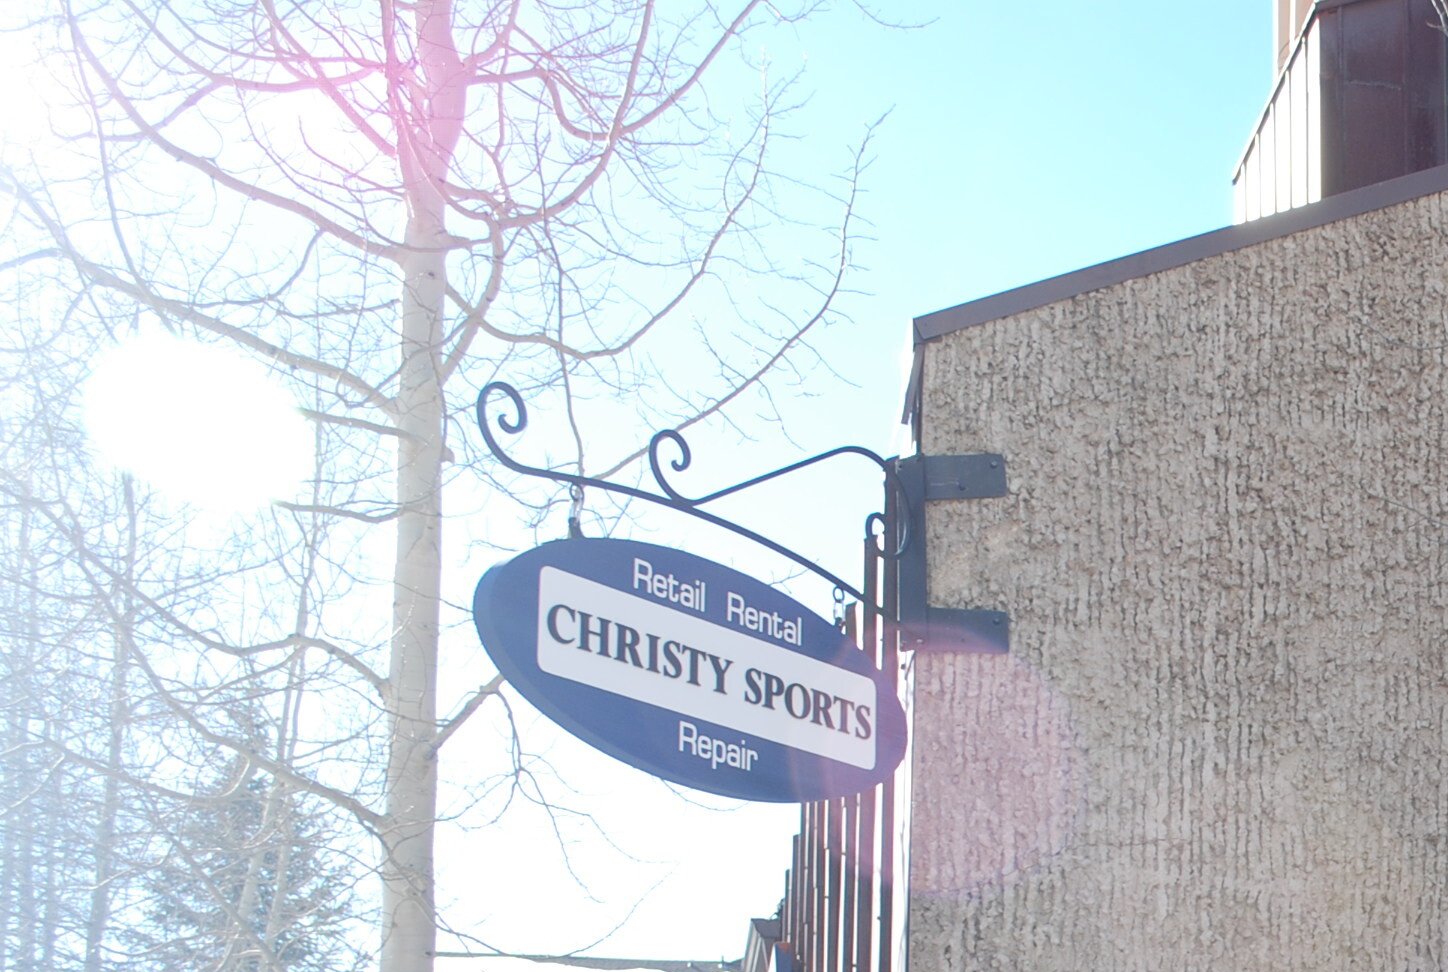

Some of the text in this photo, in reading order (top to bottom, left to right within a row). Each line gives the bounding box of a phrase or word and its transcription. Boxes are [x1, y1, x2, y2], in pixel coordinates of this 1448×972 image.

[633, 557, 803, 646] Retail Rental
[546, 603, 872, 740] CHRISTY SPORTS
[678, 721, 758, 771] Repair
